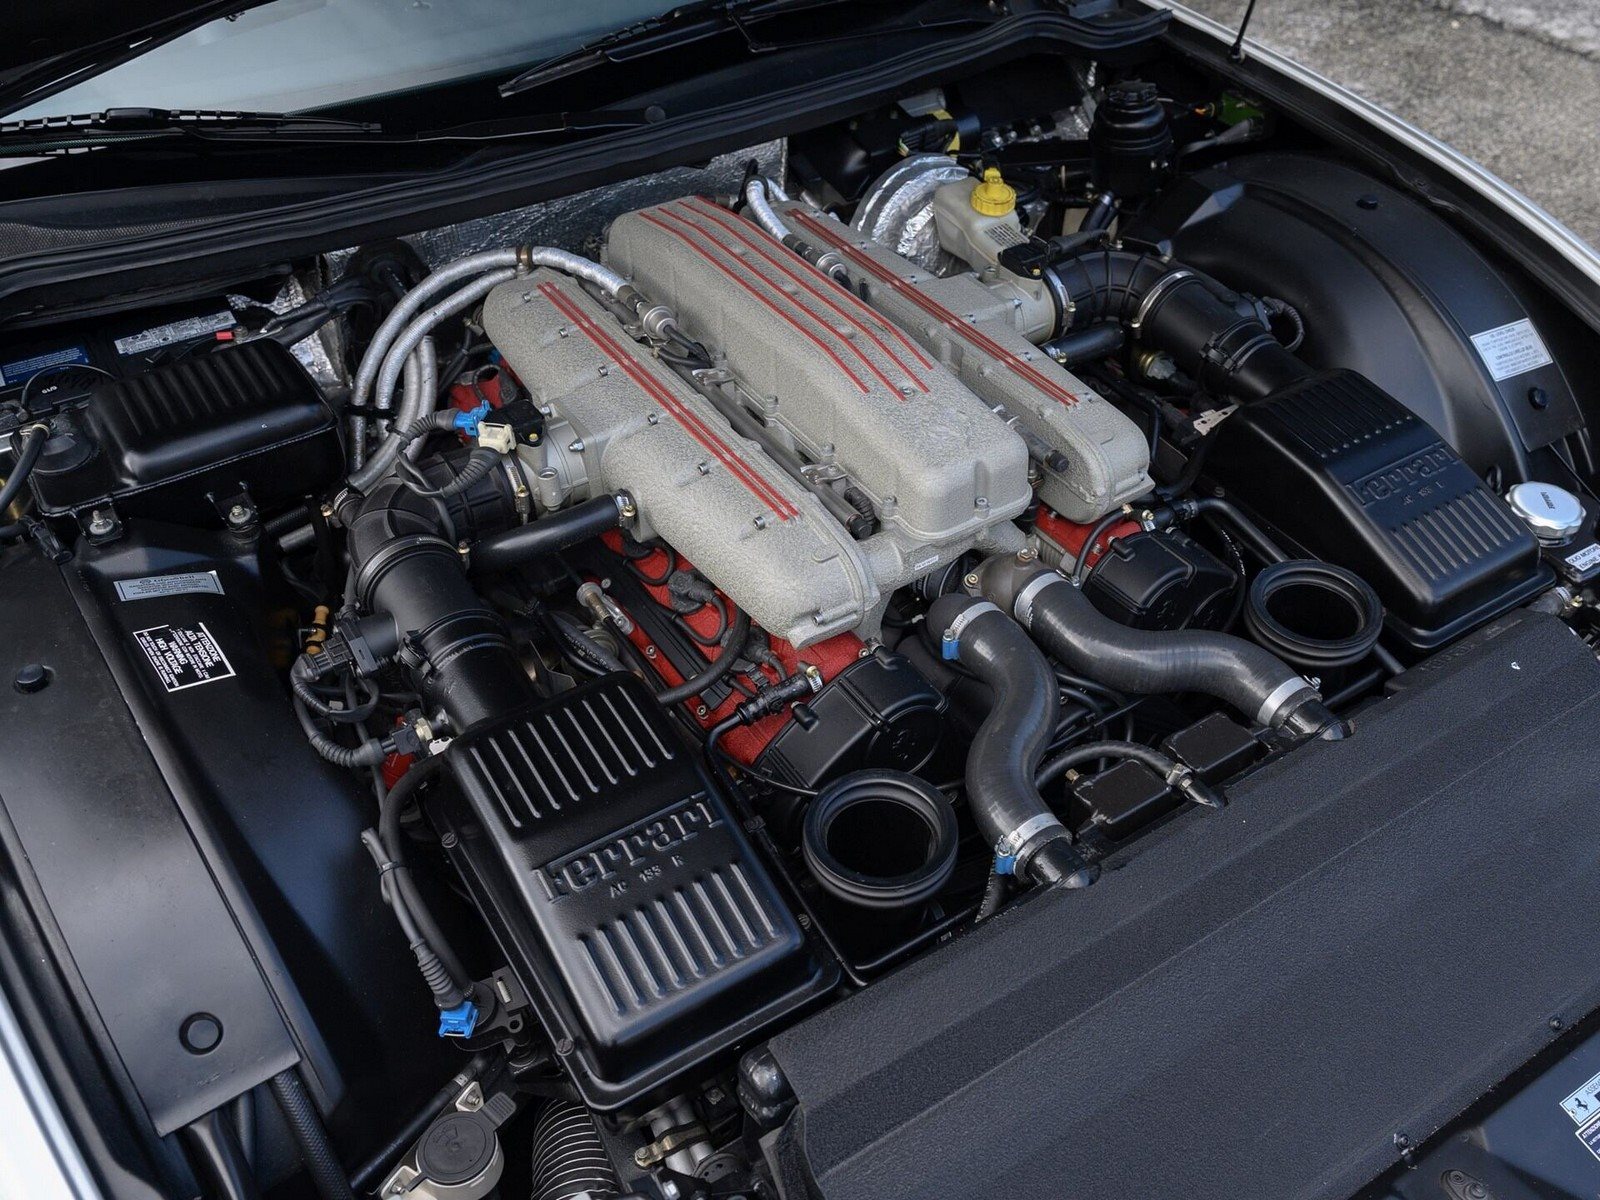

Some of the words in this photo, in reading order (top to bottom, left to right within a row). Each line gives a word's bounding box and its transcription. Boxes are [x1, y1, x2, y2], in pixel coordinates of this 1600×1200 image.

[1345, 442, 1463, 508] Ferrari
[155, 637, 169, 651] HIGH
[164, 651, 184, 675] VOLTAGE
[168, 640, 188, 665] WARNING
[193, 641, 215, 668] TENSIONE
[195, 631, 221, 662] ATTENZIONE
[531, 791, 724, 904] Ferrari
[670, 854, 687, 869] R
